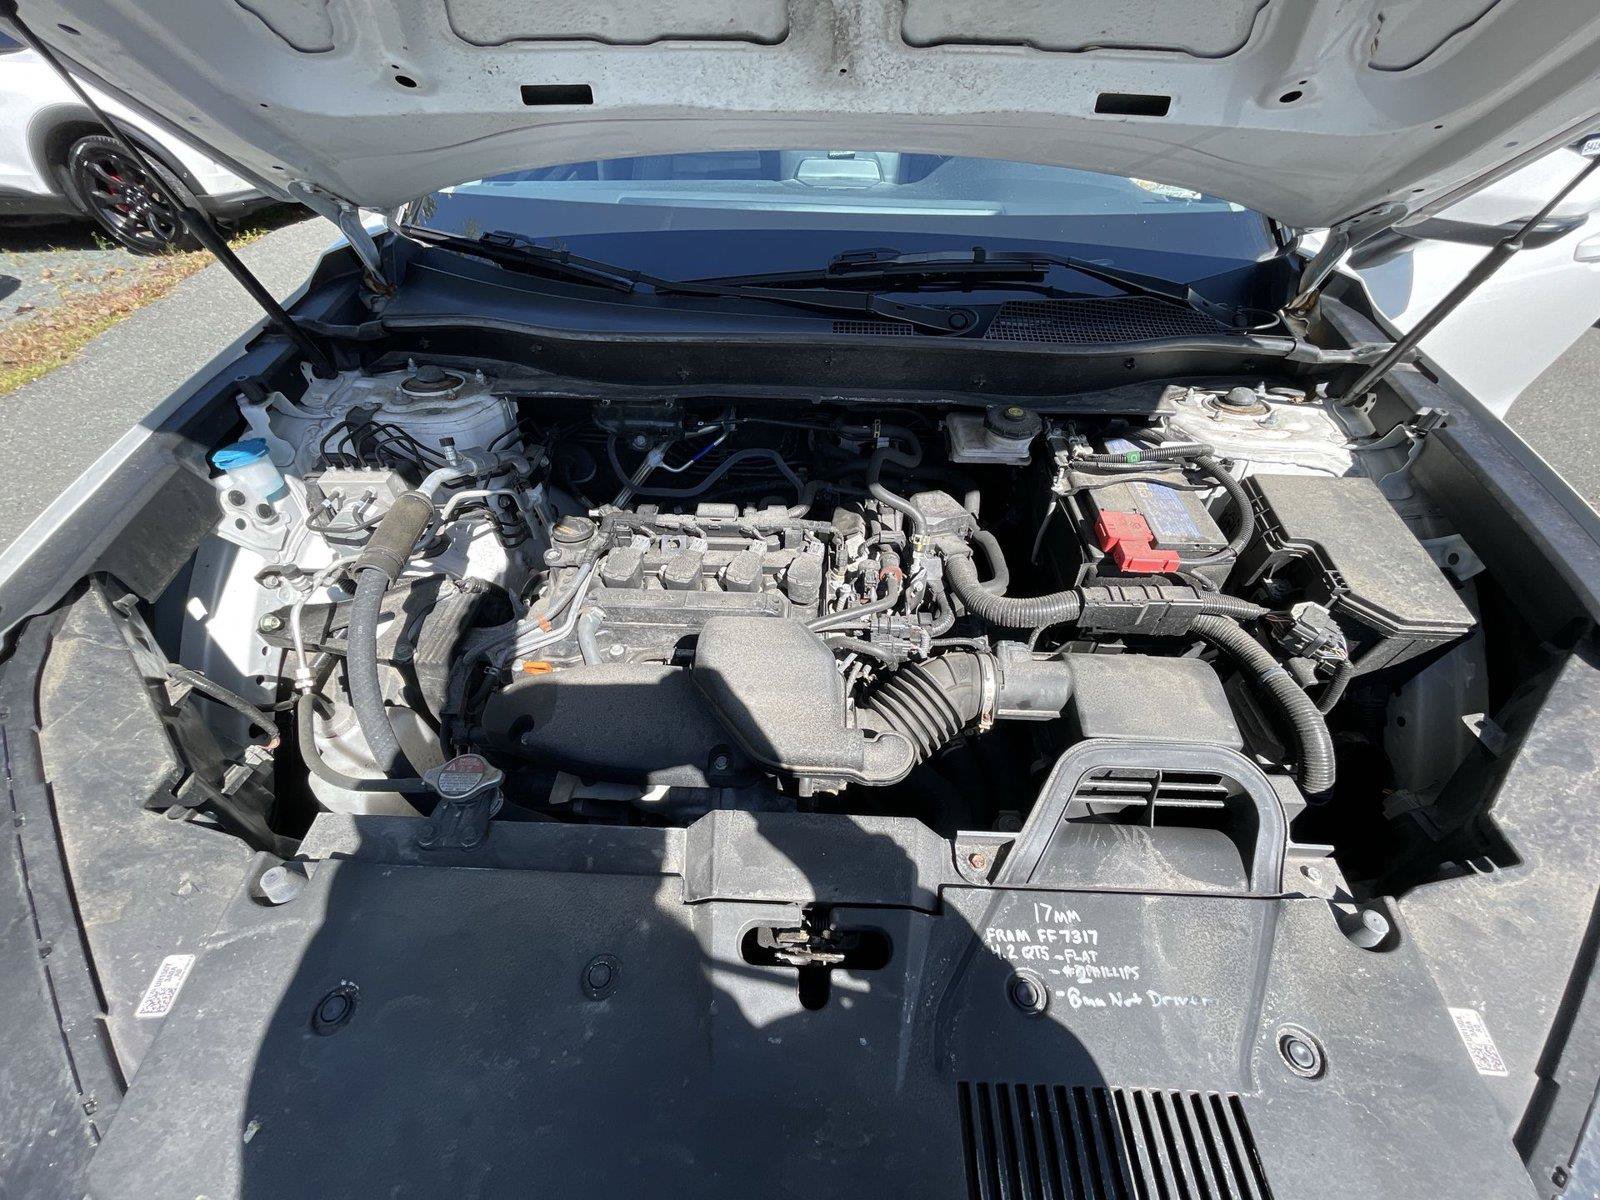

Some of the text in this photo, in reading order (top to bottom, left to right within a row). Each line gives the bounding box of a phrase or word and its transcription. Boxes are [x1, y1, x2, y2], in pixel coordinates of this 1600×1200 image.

[985, 927, 1032, 943] FRAM
[990, 943, 1019, 960] 4.2
[1021, 945, 1050, 961] QTS
